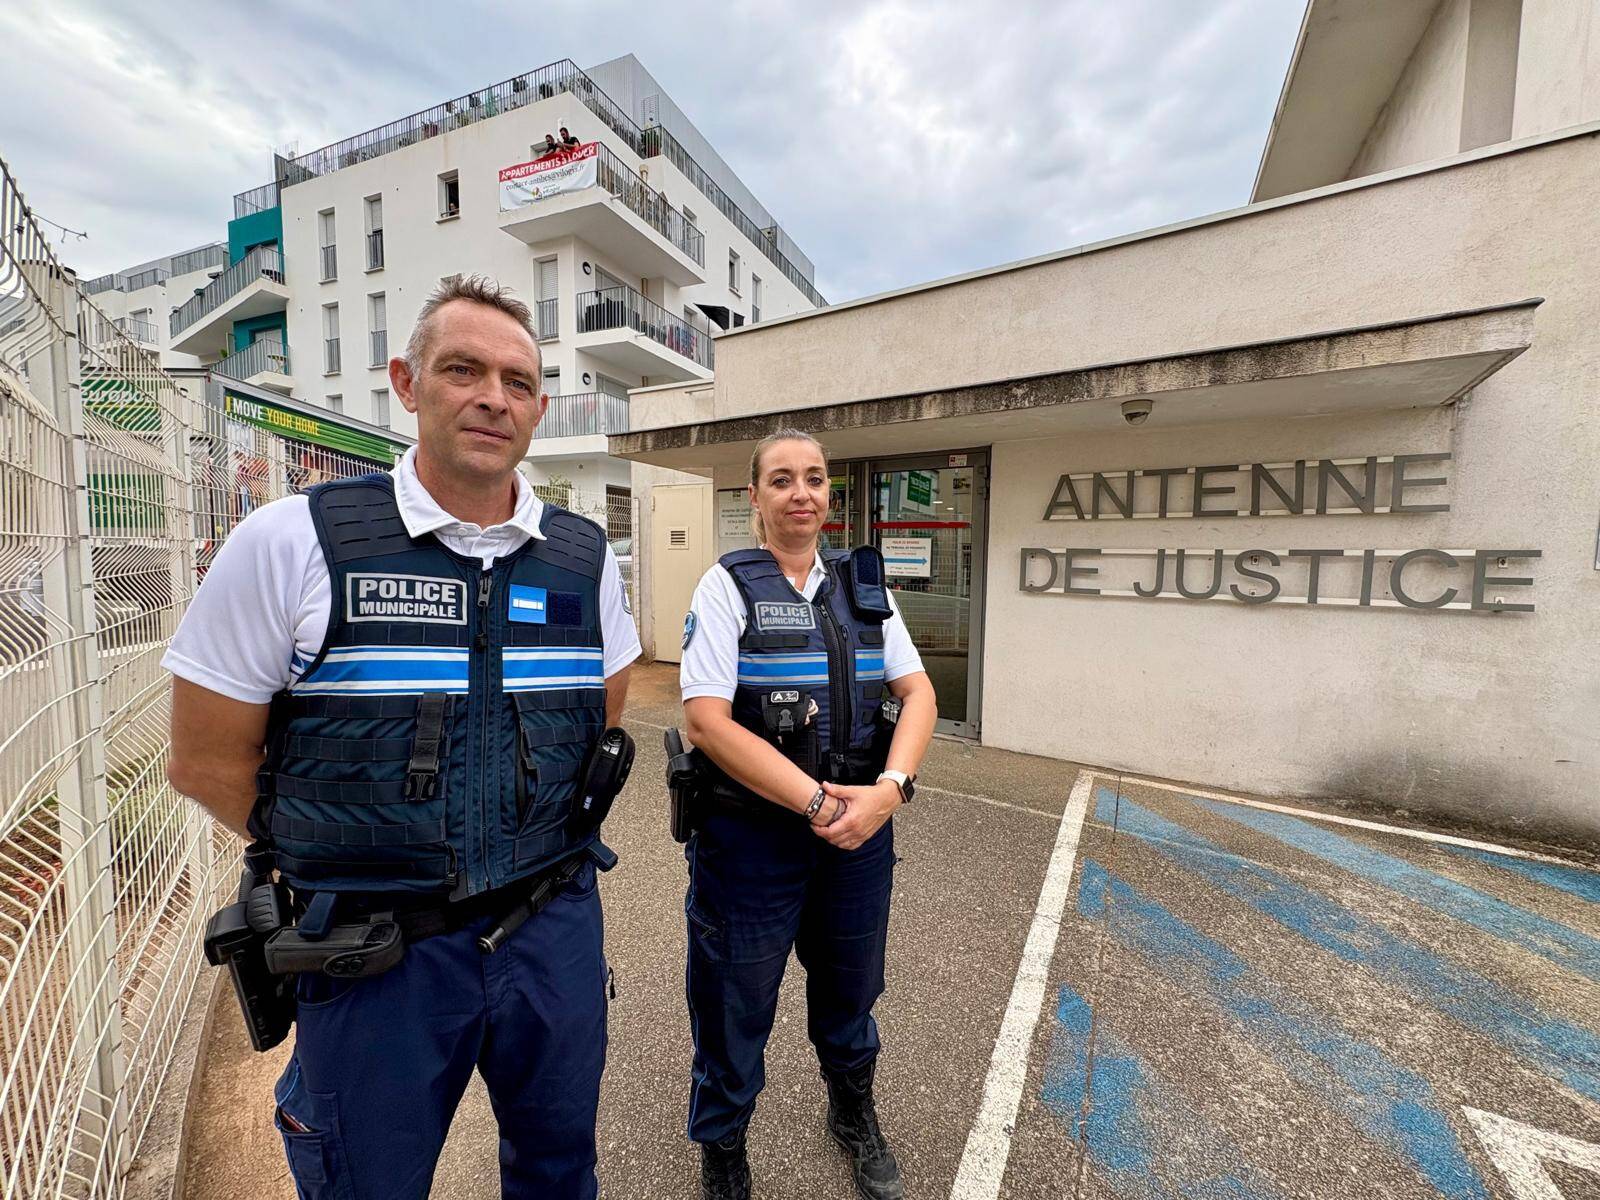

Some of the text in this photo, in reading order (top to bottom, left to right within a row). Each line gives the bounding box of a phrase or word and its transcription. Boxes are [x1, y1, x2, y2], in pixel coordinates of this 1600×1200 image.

[568, 145, 595, 163] LOUER
[233, 397, 321, 436] MOVE YOUR HOME
[1043, 452, 1452, 520] ANTENNE
[1019, 547, 1542, 613] DE JUSTICE
[359, 579, 456, 603] POLICE
[359, 602, 456, 617] MUNICIPALE
[761, 606, 808, 617] POLICE
[761, 618, 810, 626] MUNICIPALE
